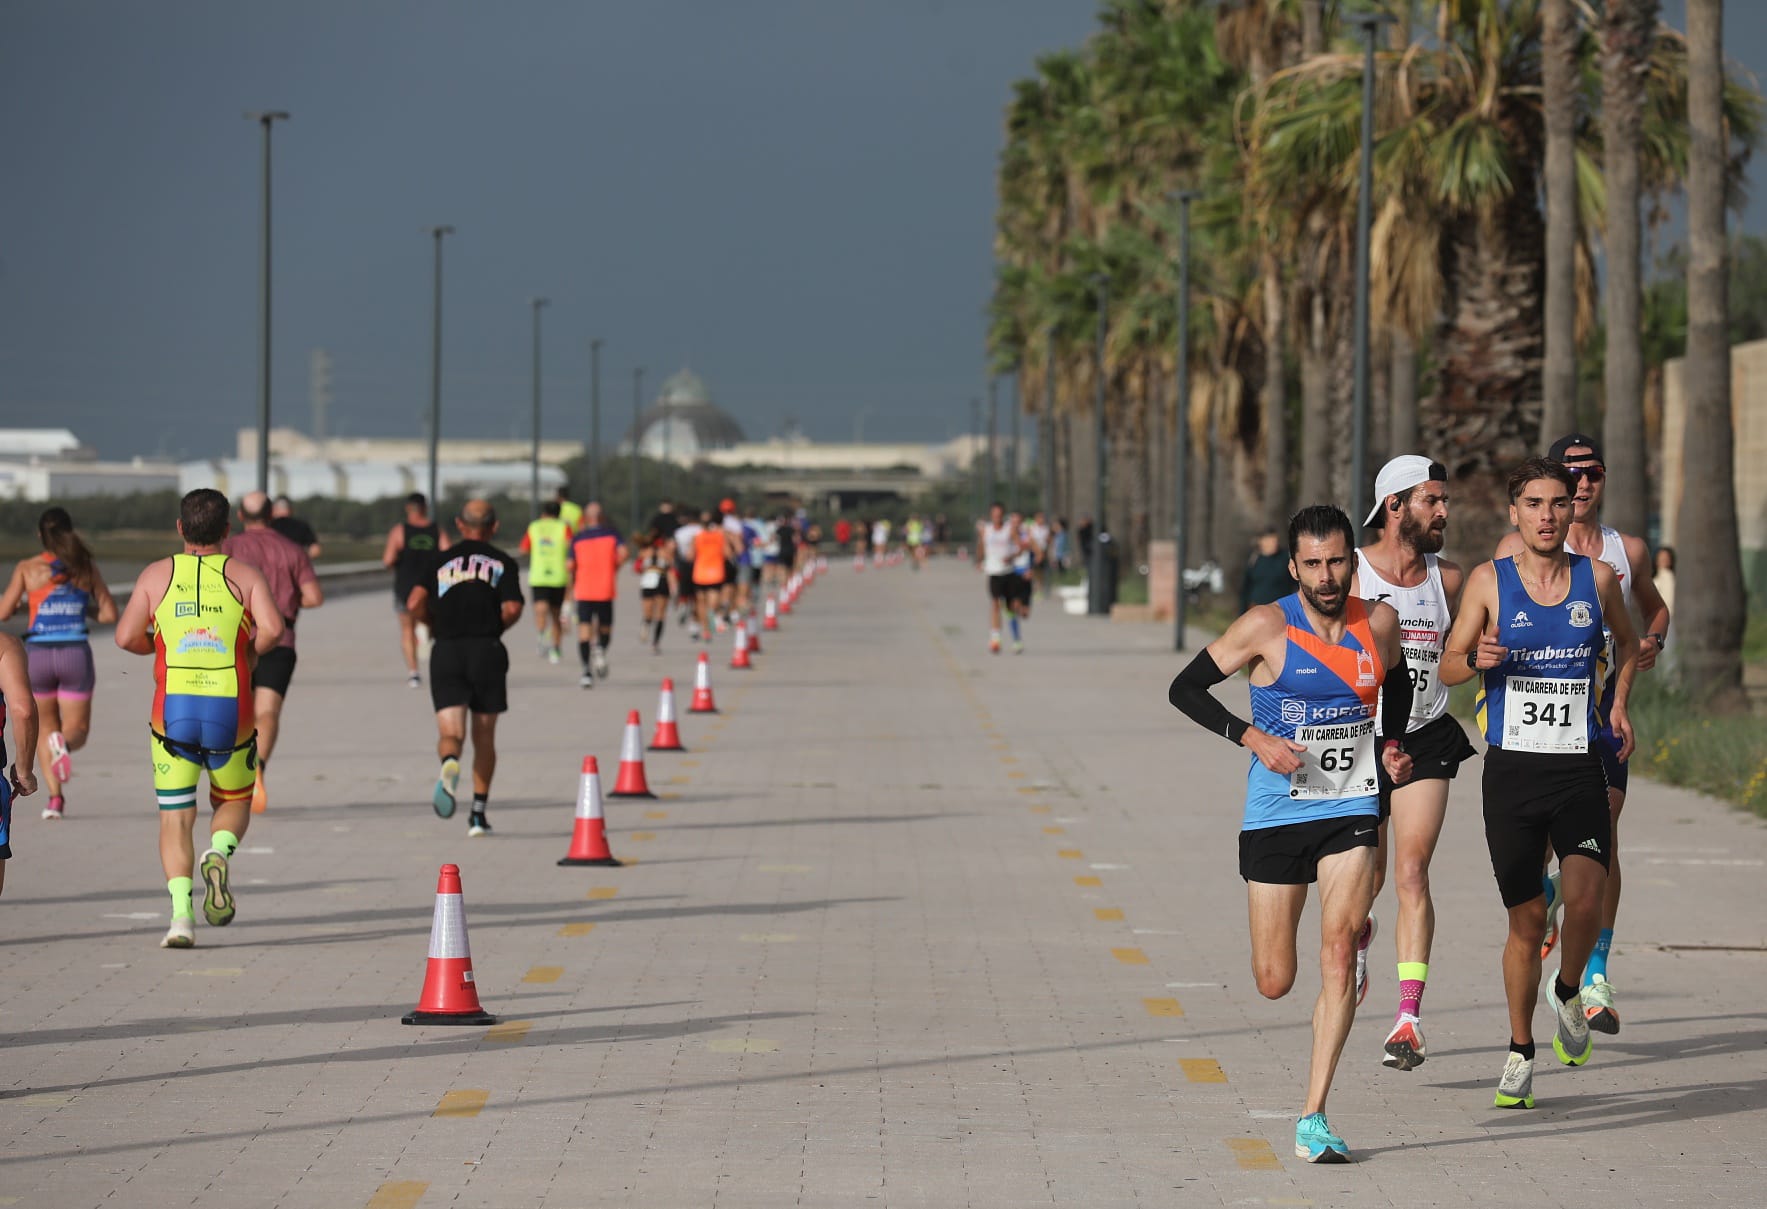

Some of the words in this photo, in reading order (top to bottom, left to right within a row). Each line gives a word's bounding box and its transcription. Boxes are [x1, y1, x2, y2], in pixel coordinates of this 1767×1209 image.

[201, 604, 223, 613] first
[1400, 617, 1434, 629] unchip
[1401, 646, 1421, 661] RRERA
[1510, 643, 1592, 662] Tirabuzón
[1296, 667, 1318, 675] mobel
[1512, 680, 1524, 692] XVI
[1525, 681, 1558, 694] CARRERA
[1560, 682, 1569, 695] DE
[1570, 683, 1586, 696] PEPE
[1522, 702, 1572, 727] 341
[1301, 729, 1315, 741] XVI
[1316, 727, 1349, 741] CARRERA
[1350, 726, 1359, 738] DE
[1320, 747, 1354, 772] 65
